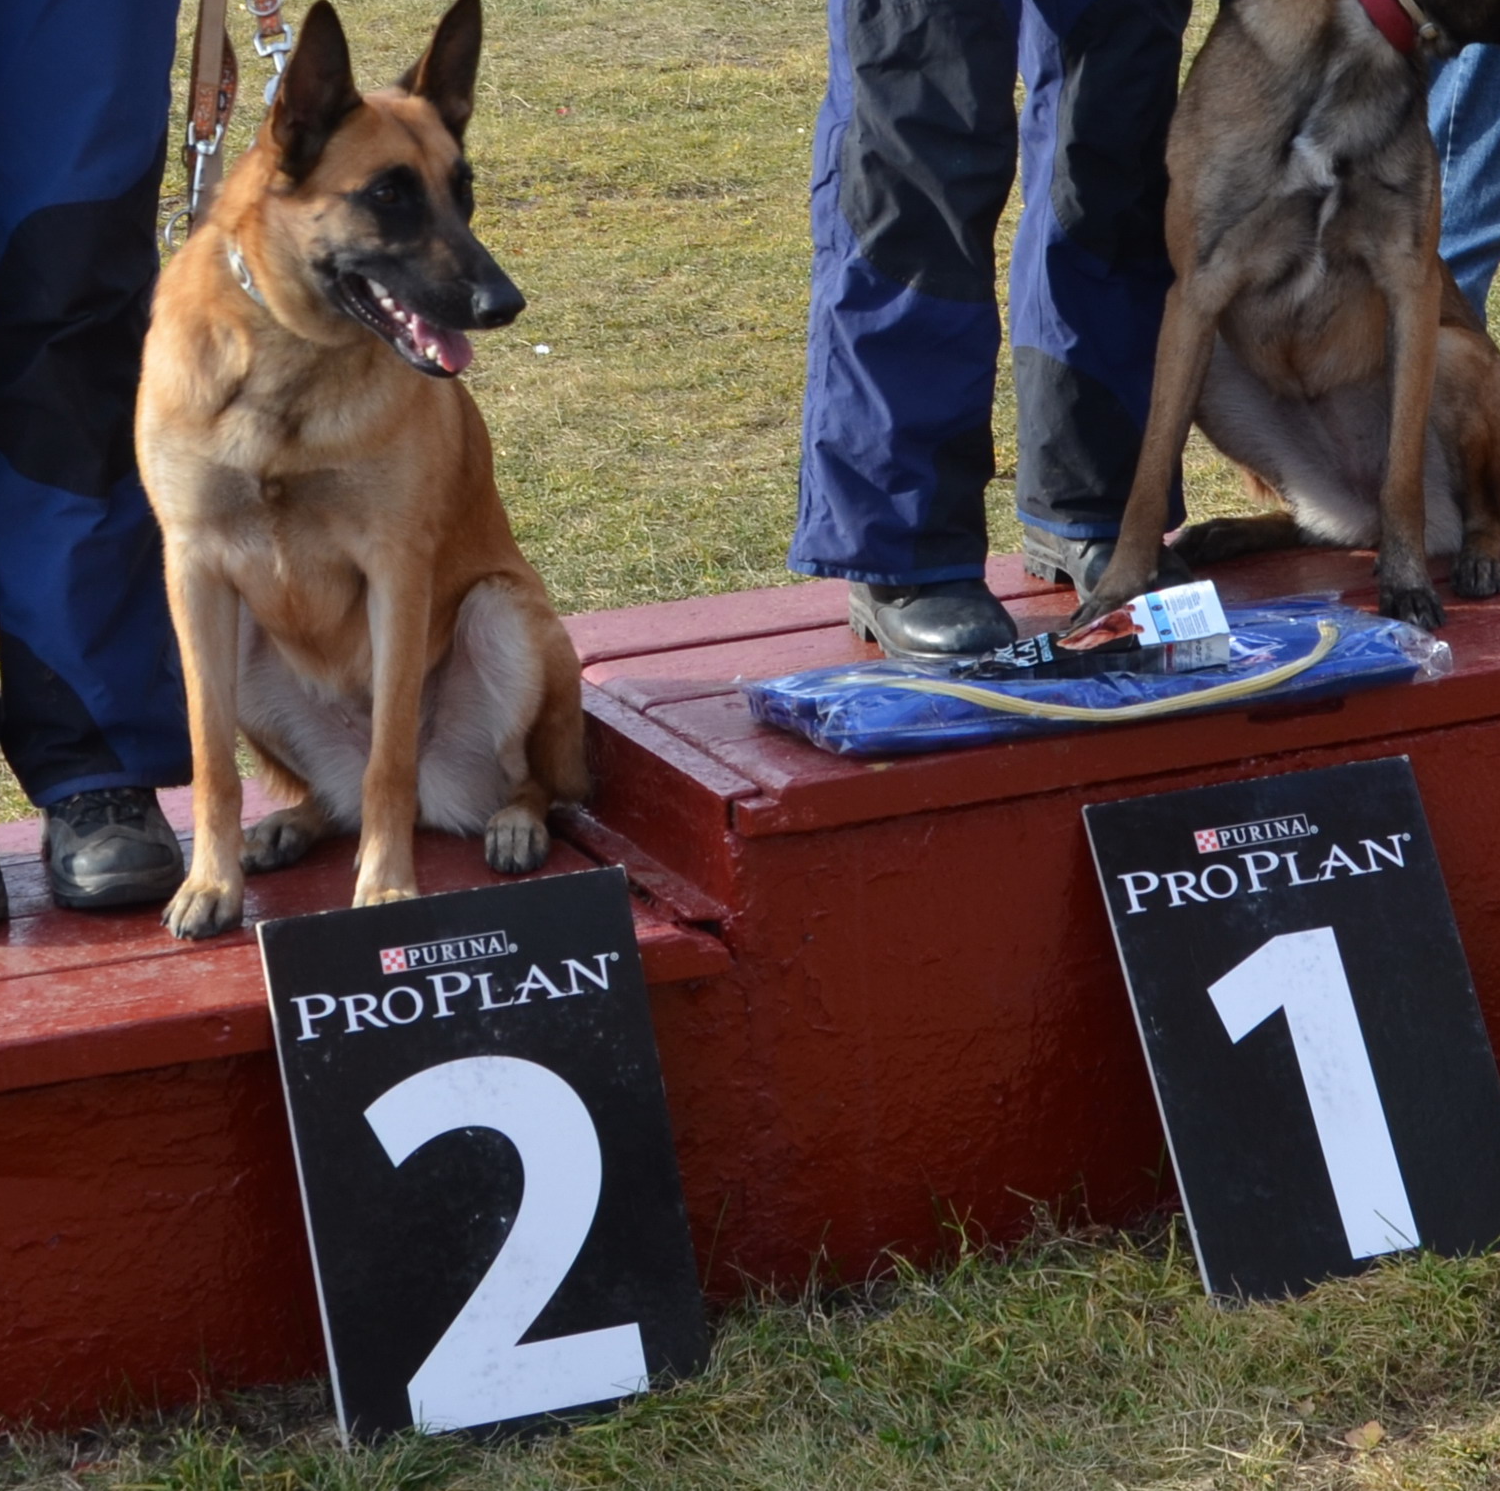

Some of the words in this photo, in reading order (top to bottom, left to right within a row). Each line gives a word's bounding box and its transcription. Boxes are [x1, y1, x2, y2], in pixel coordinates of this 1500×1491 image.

[1219, 818, 1306, 847] PURINA
[407, 936, 504, 968] PURINA
[1207, 926, 1420, 1260] 1
[363, 1055, 649, 1436] 2
